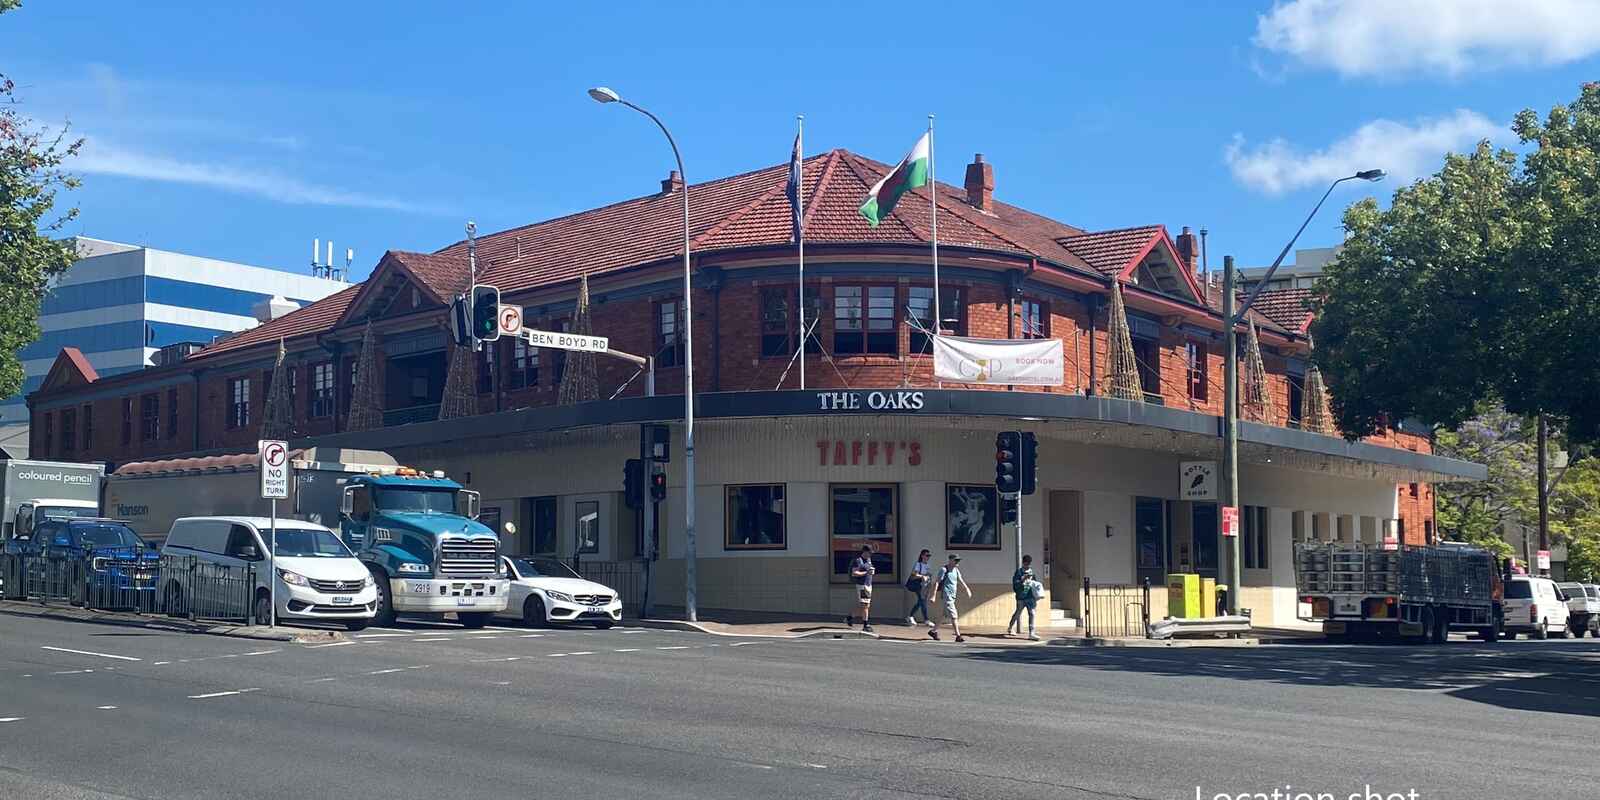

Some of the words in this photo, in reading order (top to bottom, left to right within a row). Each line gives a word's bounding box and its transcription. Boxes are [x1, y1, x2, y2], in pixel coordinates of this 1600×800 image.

[532, 333, 553, 345] BEN
[559, 336, 586, 348] BOYD
[592, 339, 606, 349] RD
[817, 392, 860, 409] THE
[867, 392, 925, 409] OAKS
[817, 440, 922, 466] TAFFY'S
[18, 470, 61, 481] coloured
[63, 473, 92, 484] pencil
[268, 469, 282, 478] NO
[1184, 465, 1210, 476] BOTTLE
[265, 479, 286, 487] RIGHT
[265, 487, 286, 495] TURN
[117, 503, 149, 516] Hanson
